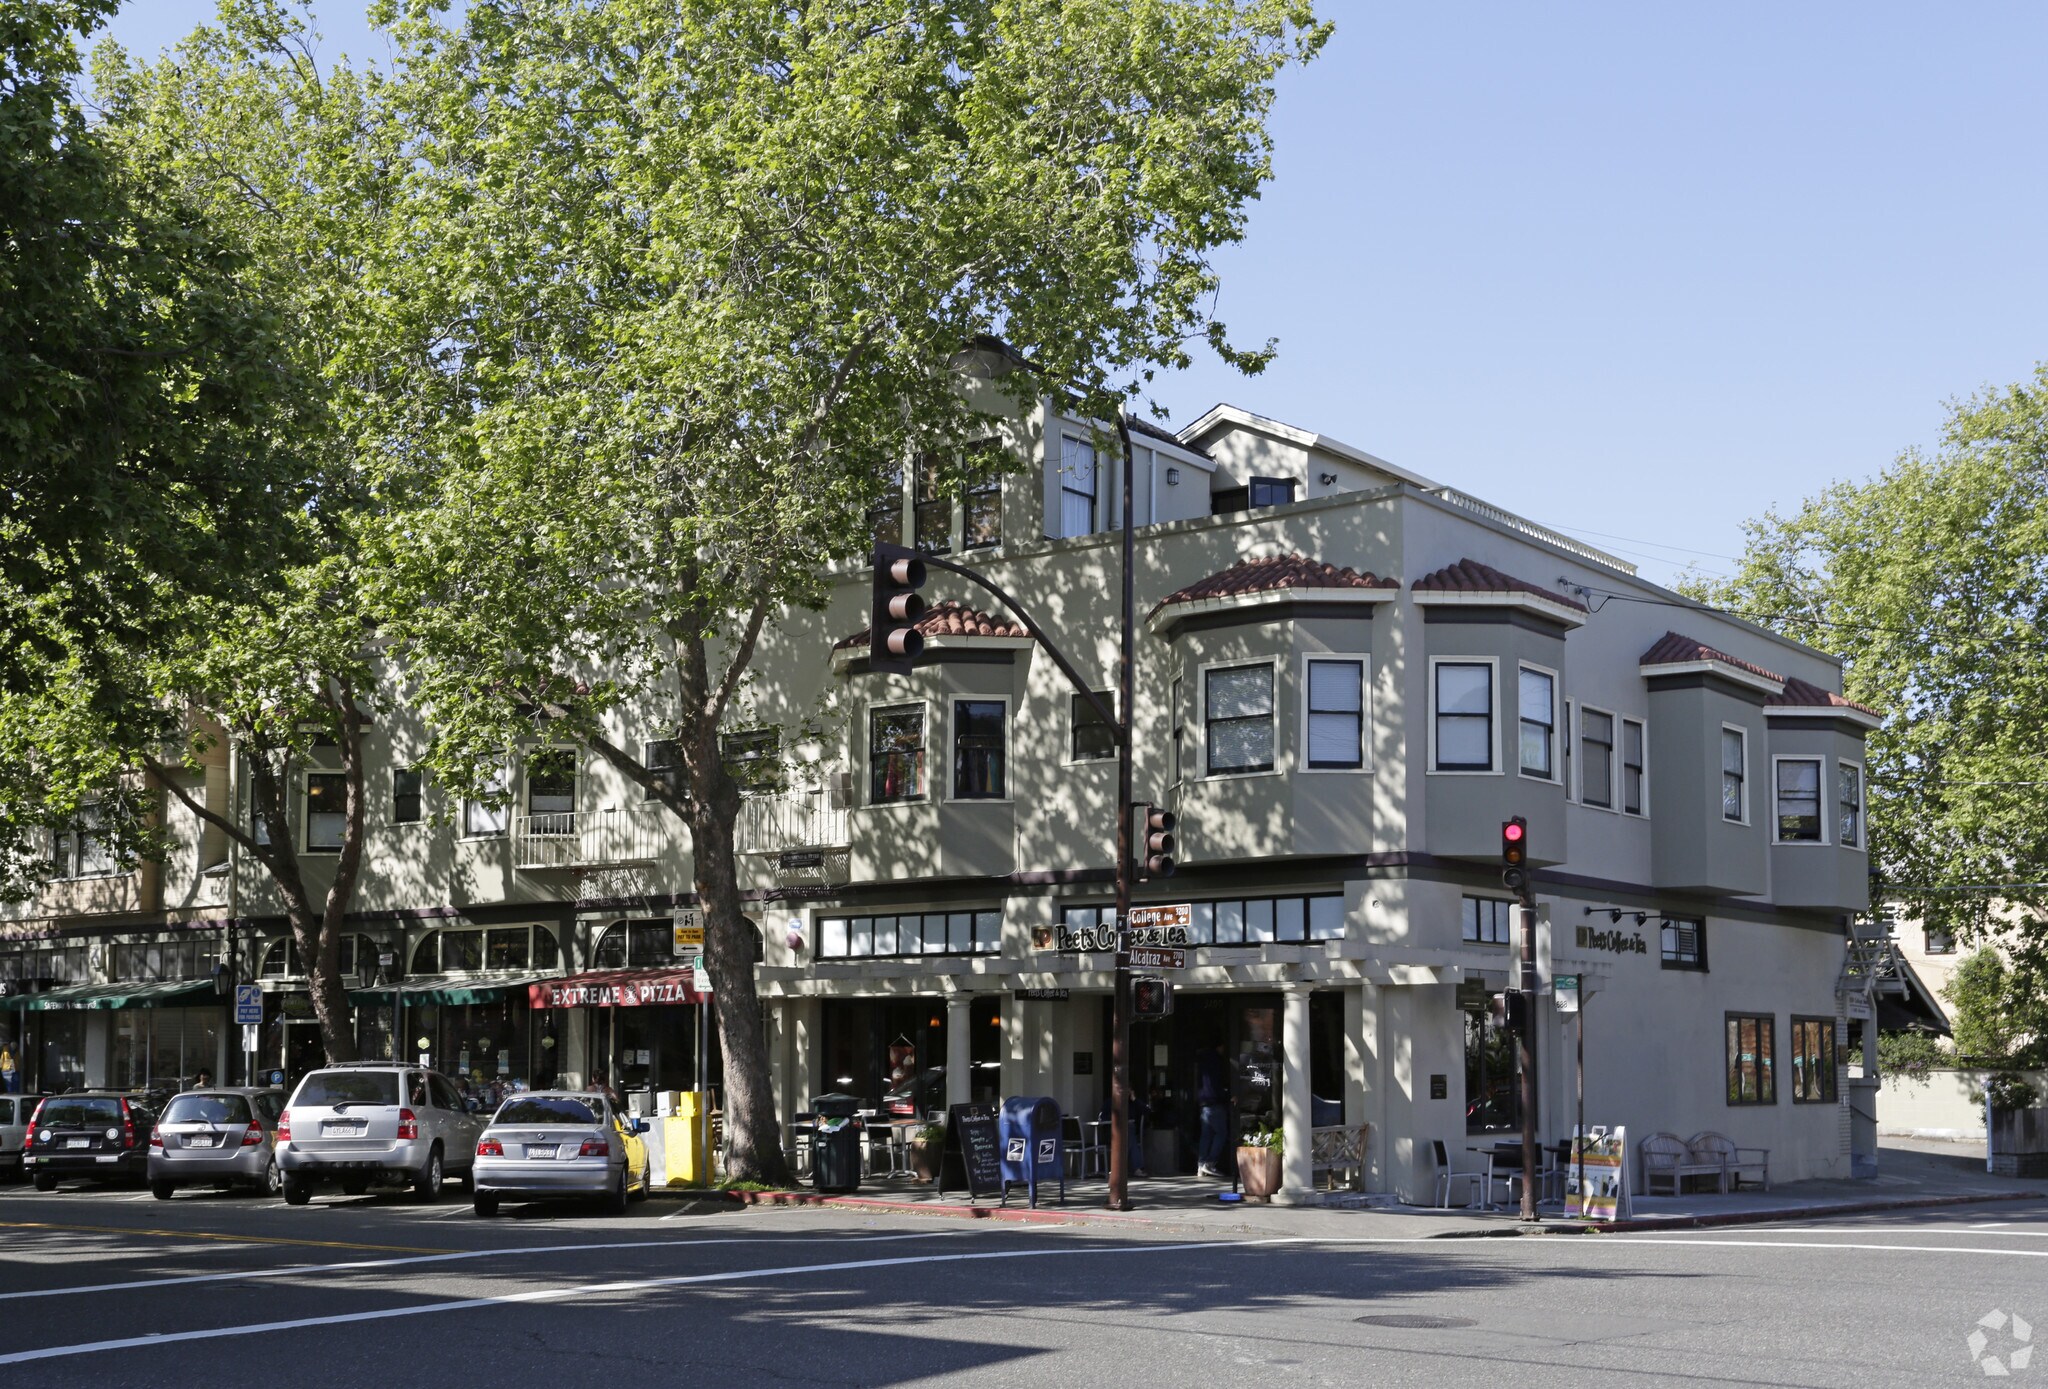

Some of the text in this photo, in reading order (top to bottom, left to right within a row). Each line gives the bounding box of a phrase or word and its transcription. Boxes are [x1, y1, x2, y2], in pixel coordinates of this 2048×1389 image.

[1131, 911, 1160, 926] College
[1176, 905, 1189, 915] 3200
[1056, 924, 1095, 950] Peet's
[1097, 924, 1144, 949] Coee
[1147, 929, 1160, 944] &
[1130, 949, 1161, 965] Alcatraz
[1174, 951, 1184, 960] 2700
[552, 984, 685, 1005] EXTREME PIZZA
